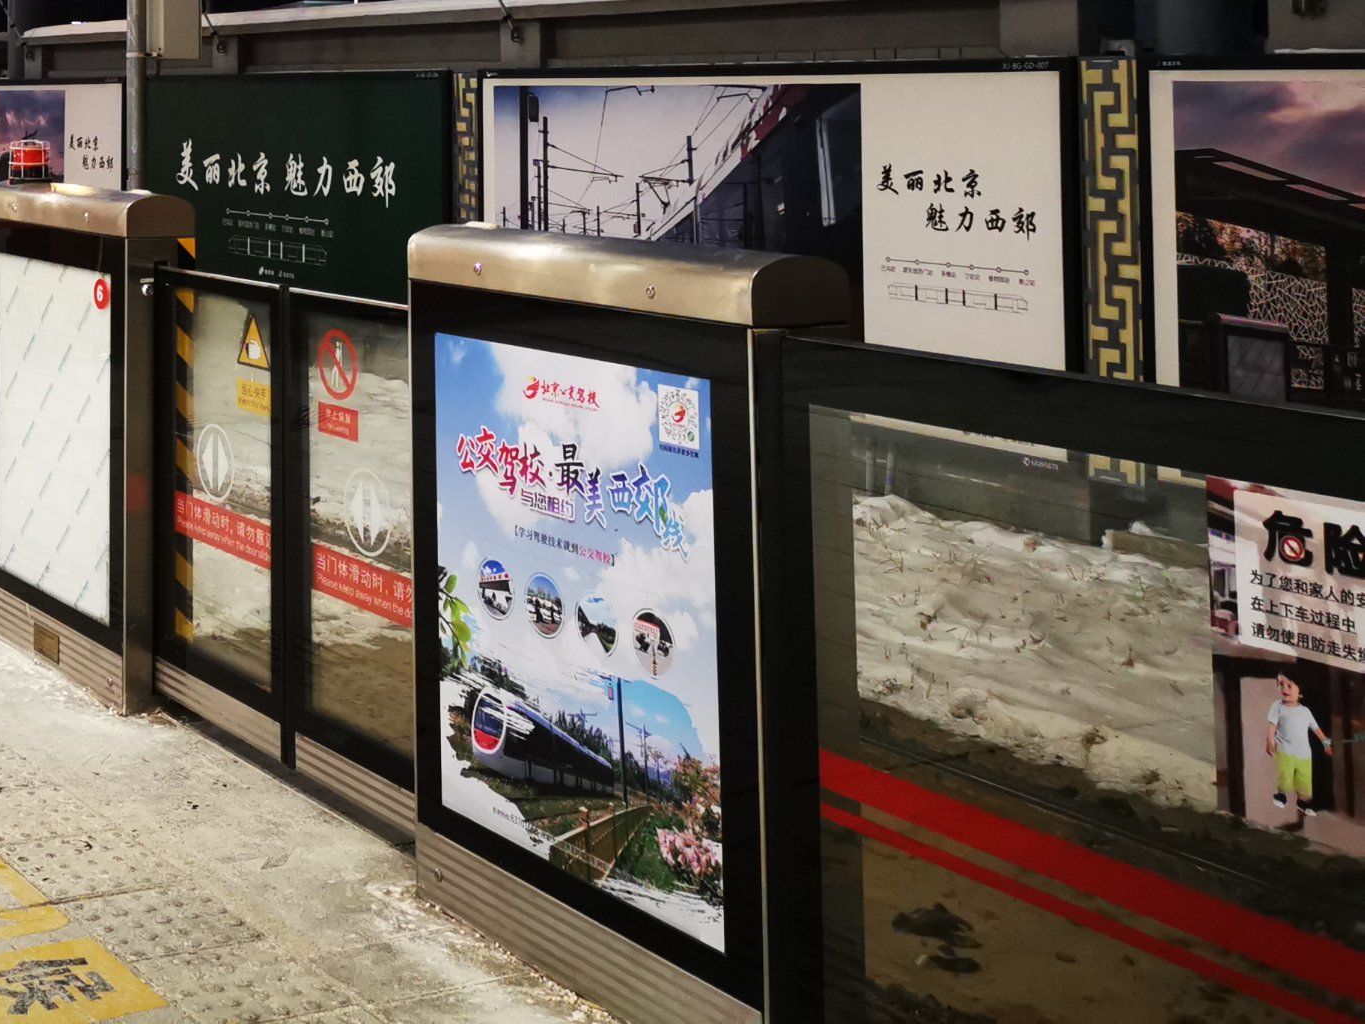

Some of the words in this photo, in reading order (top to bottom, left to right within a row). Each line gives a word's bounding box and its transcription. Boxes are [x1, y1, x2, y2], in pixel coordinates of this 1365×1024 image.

[68, 133, 99, 152] 美丽北京
[82, 154, 114, 172] 魅力西郊
[176, 137, 271, 195] 美丽北京
[284, 153, 396, 208] 魅力西郊
[876, 163, 982, 199] 美丽北京
[925, 203, 1038, 241] 魅力西郊
[96, 284, 104, 302] 6
[541, 379, 600, 408] 北京公交驾校
[521, 489, 575, 520] 与您相约
[1262, 510, 1365, 580] 危险
[317, 573, 338, 589] Please
[393, 603, 403, 615] the
[1250, 569, 1365, 607] 为了您和家人的安
[1251, 596, 1356, 632] 在上下车过程中
